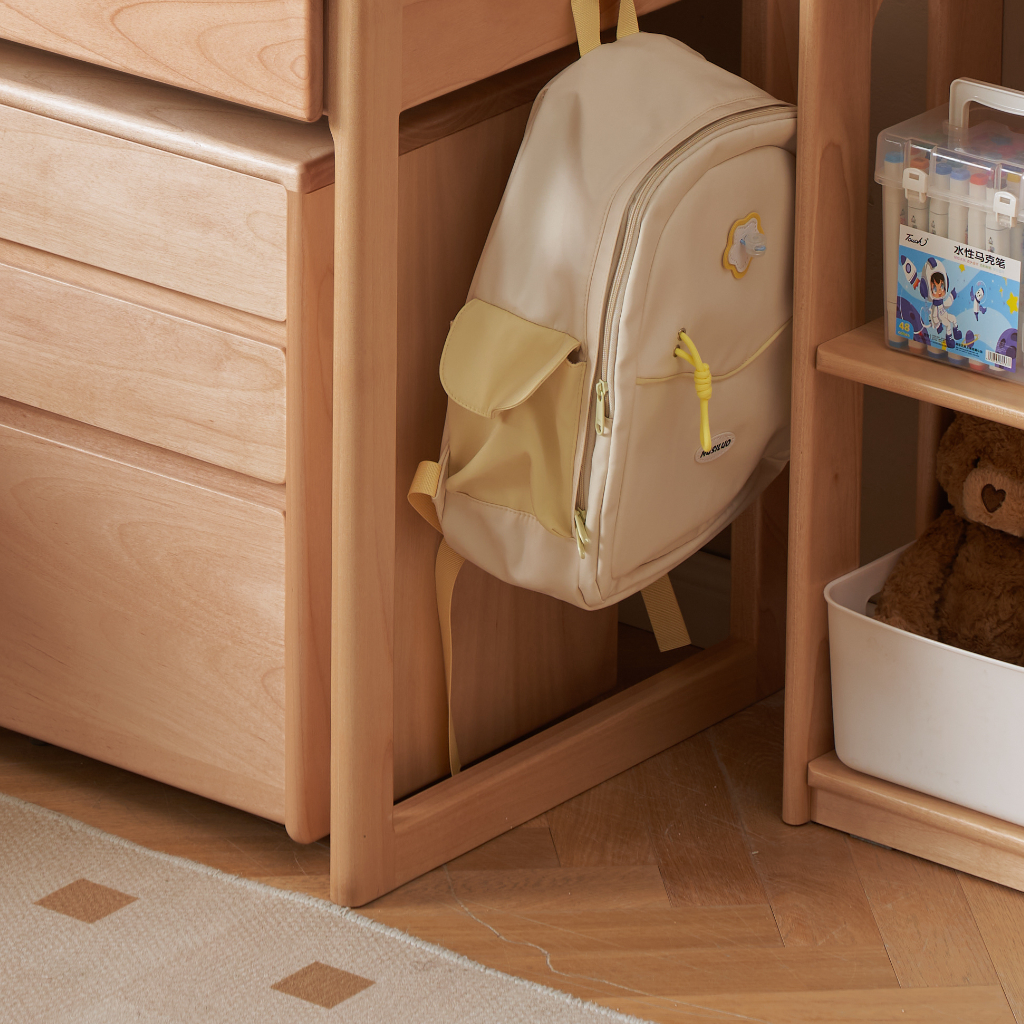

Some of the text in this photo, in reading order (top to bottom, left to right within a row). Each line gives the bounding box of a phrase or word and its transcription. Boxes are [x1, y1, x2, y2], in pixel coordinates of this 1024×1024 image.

[953, 245, 1006, 269] 水性马克笔
[898, 321, 910, 332] 48
